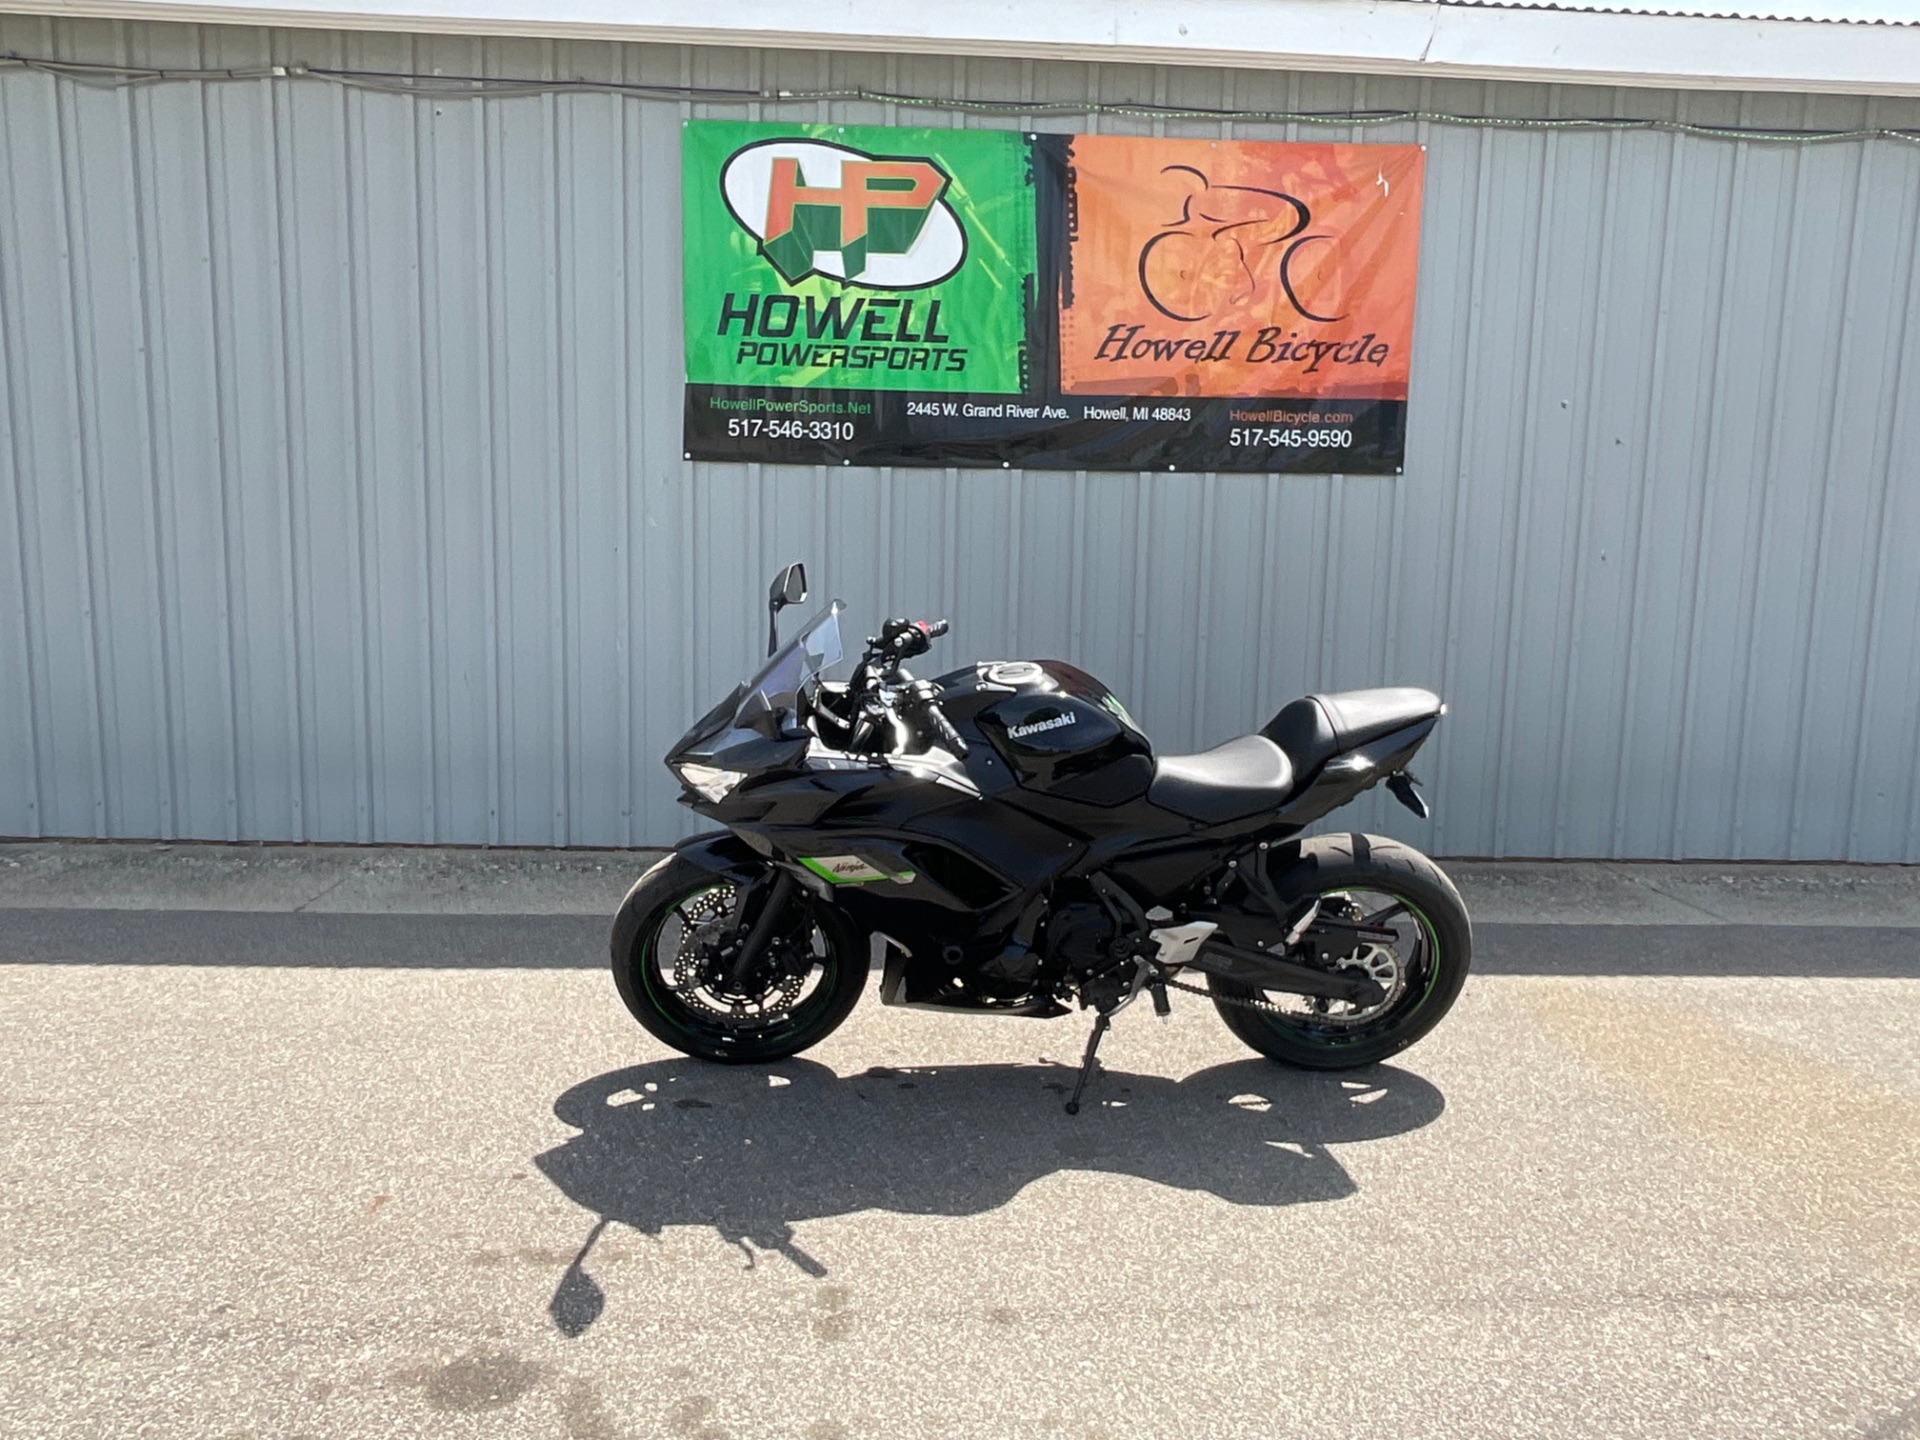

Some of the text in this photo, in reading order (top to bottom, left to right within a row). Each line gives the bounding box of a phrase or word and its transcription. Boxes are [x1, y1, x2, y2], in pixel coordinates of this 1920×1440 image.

[763, 156, 948, 283] HP
[716, 293, 950, 343] HOWELL
[736, 341, 968, 372] POWERSPORTS
[1094, 323, 1390, 374] Howell Bicycle
[709, 396, 872, 415] HowellPowerSports.Net
[906, 402, 1192, 422] 2445 W. Grand River Ave. Howell, MI 48843
[1229, 409, 1354, 426] HowellBicycle.com
[727, 418, 855, 441] 517-546-3310
[1229, 428, 1353, 448] 517-545-9590
[1007, 711, 1077, 740] Kawasaki
[832, 861, 868, 873] Ninja
